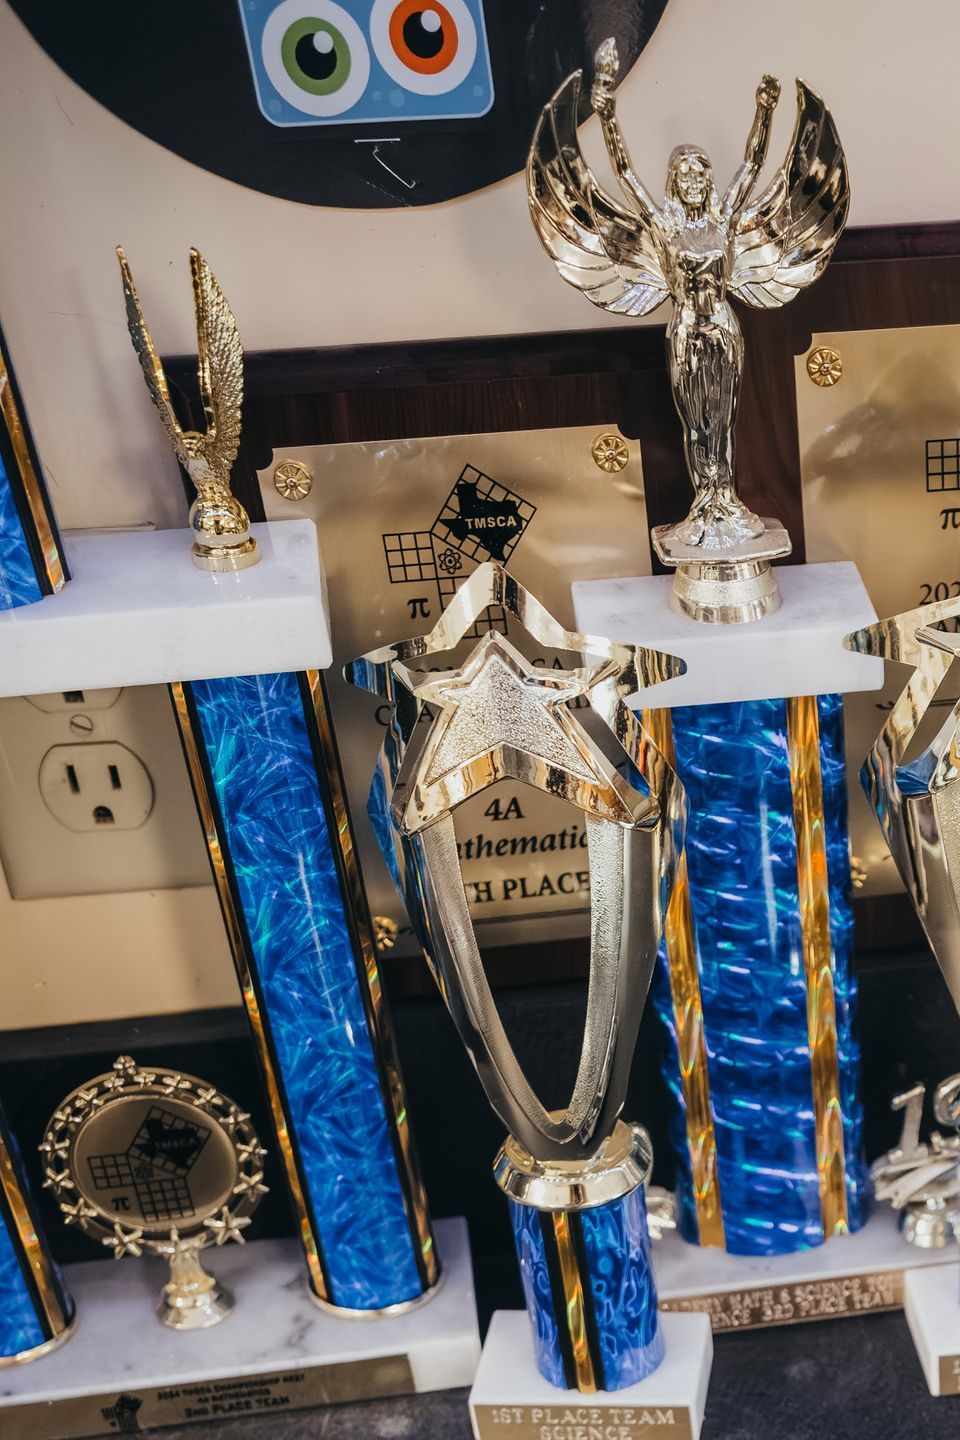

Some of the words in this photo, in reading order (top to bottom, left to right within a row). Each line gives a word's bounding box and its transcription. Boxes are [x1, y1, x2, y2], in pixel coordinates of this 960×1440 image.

[464, 515, 518, 530] TMSCA
[484, 796, 525, 822] 4A
[468, 880, 499, 904] TH
[502, 871, 591, 900] PLACE
[491, 1407, 524, 1425] 1ST
[531, 1408, 604, 1425] PLACE
[609, 1409, 676, 1426] TEAM
